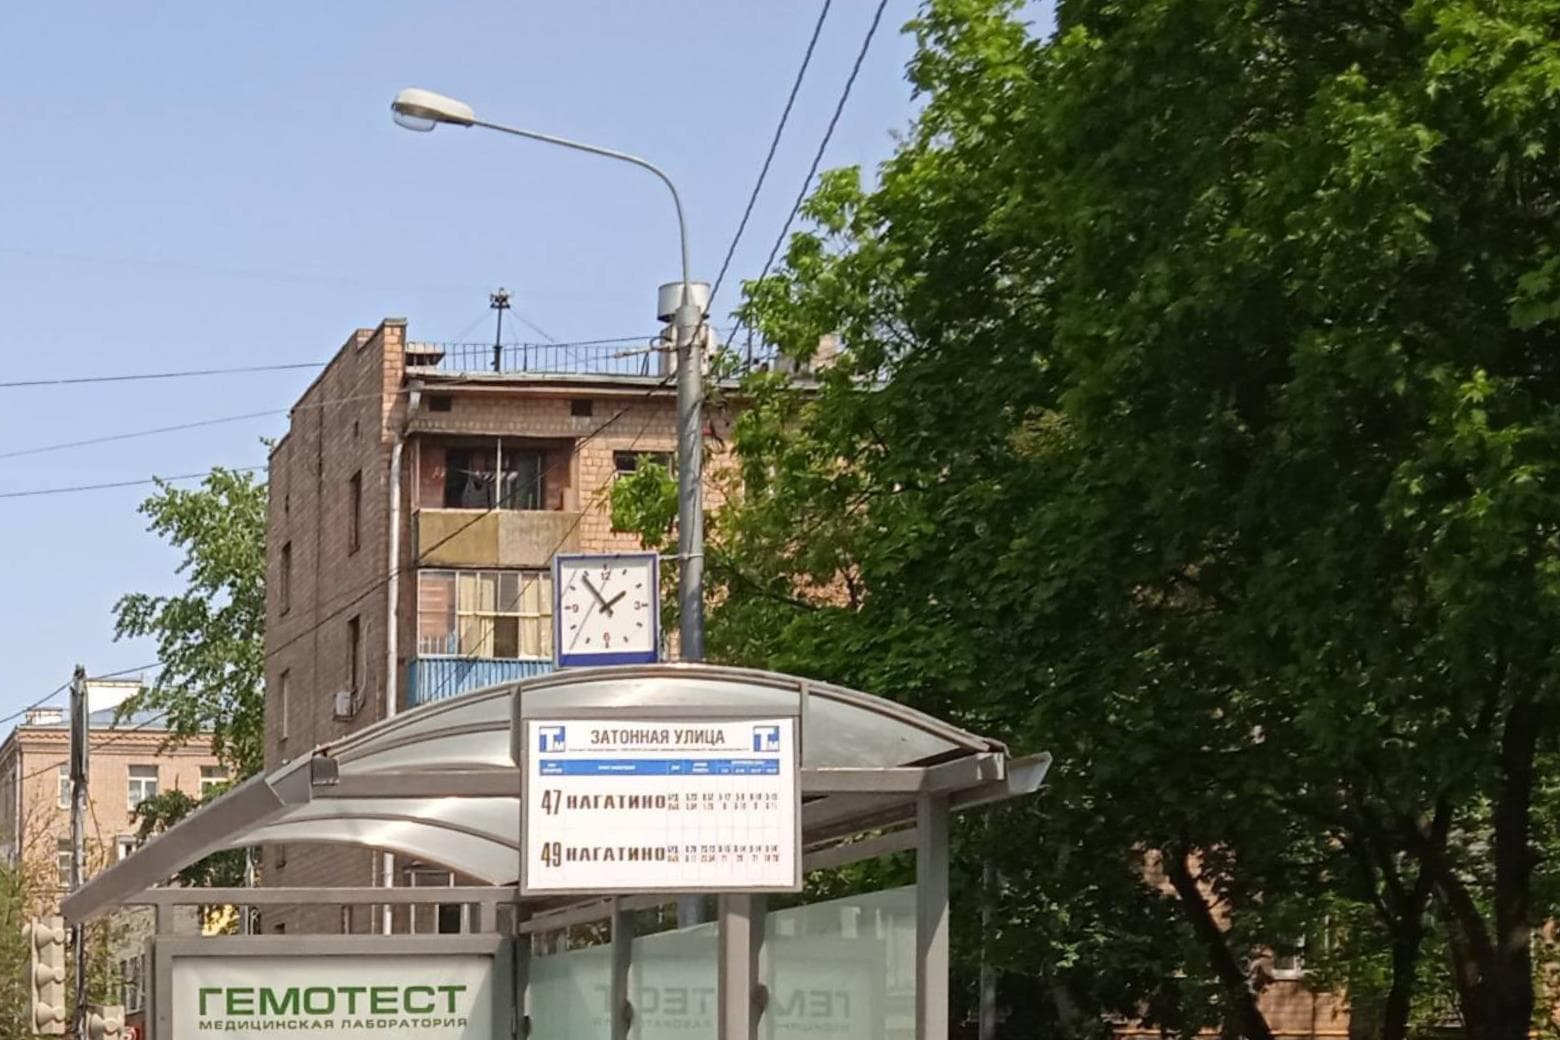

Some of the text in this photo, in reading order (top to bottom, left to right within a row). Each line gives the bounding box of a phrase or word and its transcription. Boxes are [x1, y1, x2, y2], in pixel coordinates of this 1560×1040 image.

[590, 729, 725, 745] ЗАТОННАЯ УЛИЦА
[541, 789, 562, 815] 47
[566, 794, 666, 809] НАГАТИНО
[541, 842, 562, 867] 49
[566, 847, 665, 861] НАГАТИНО
[198, 985, 468, 1016] ГЕМОТЕСТ
[199, 1017, 468, 1032] МЕДИЦИНСКАЯ ЛАБОРАТОРИЯ
